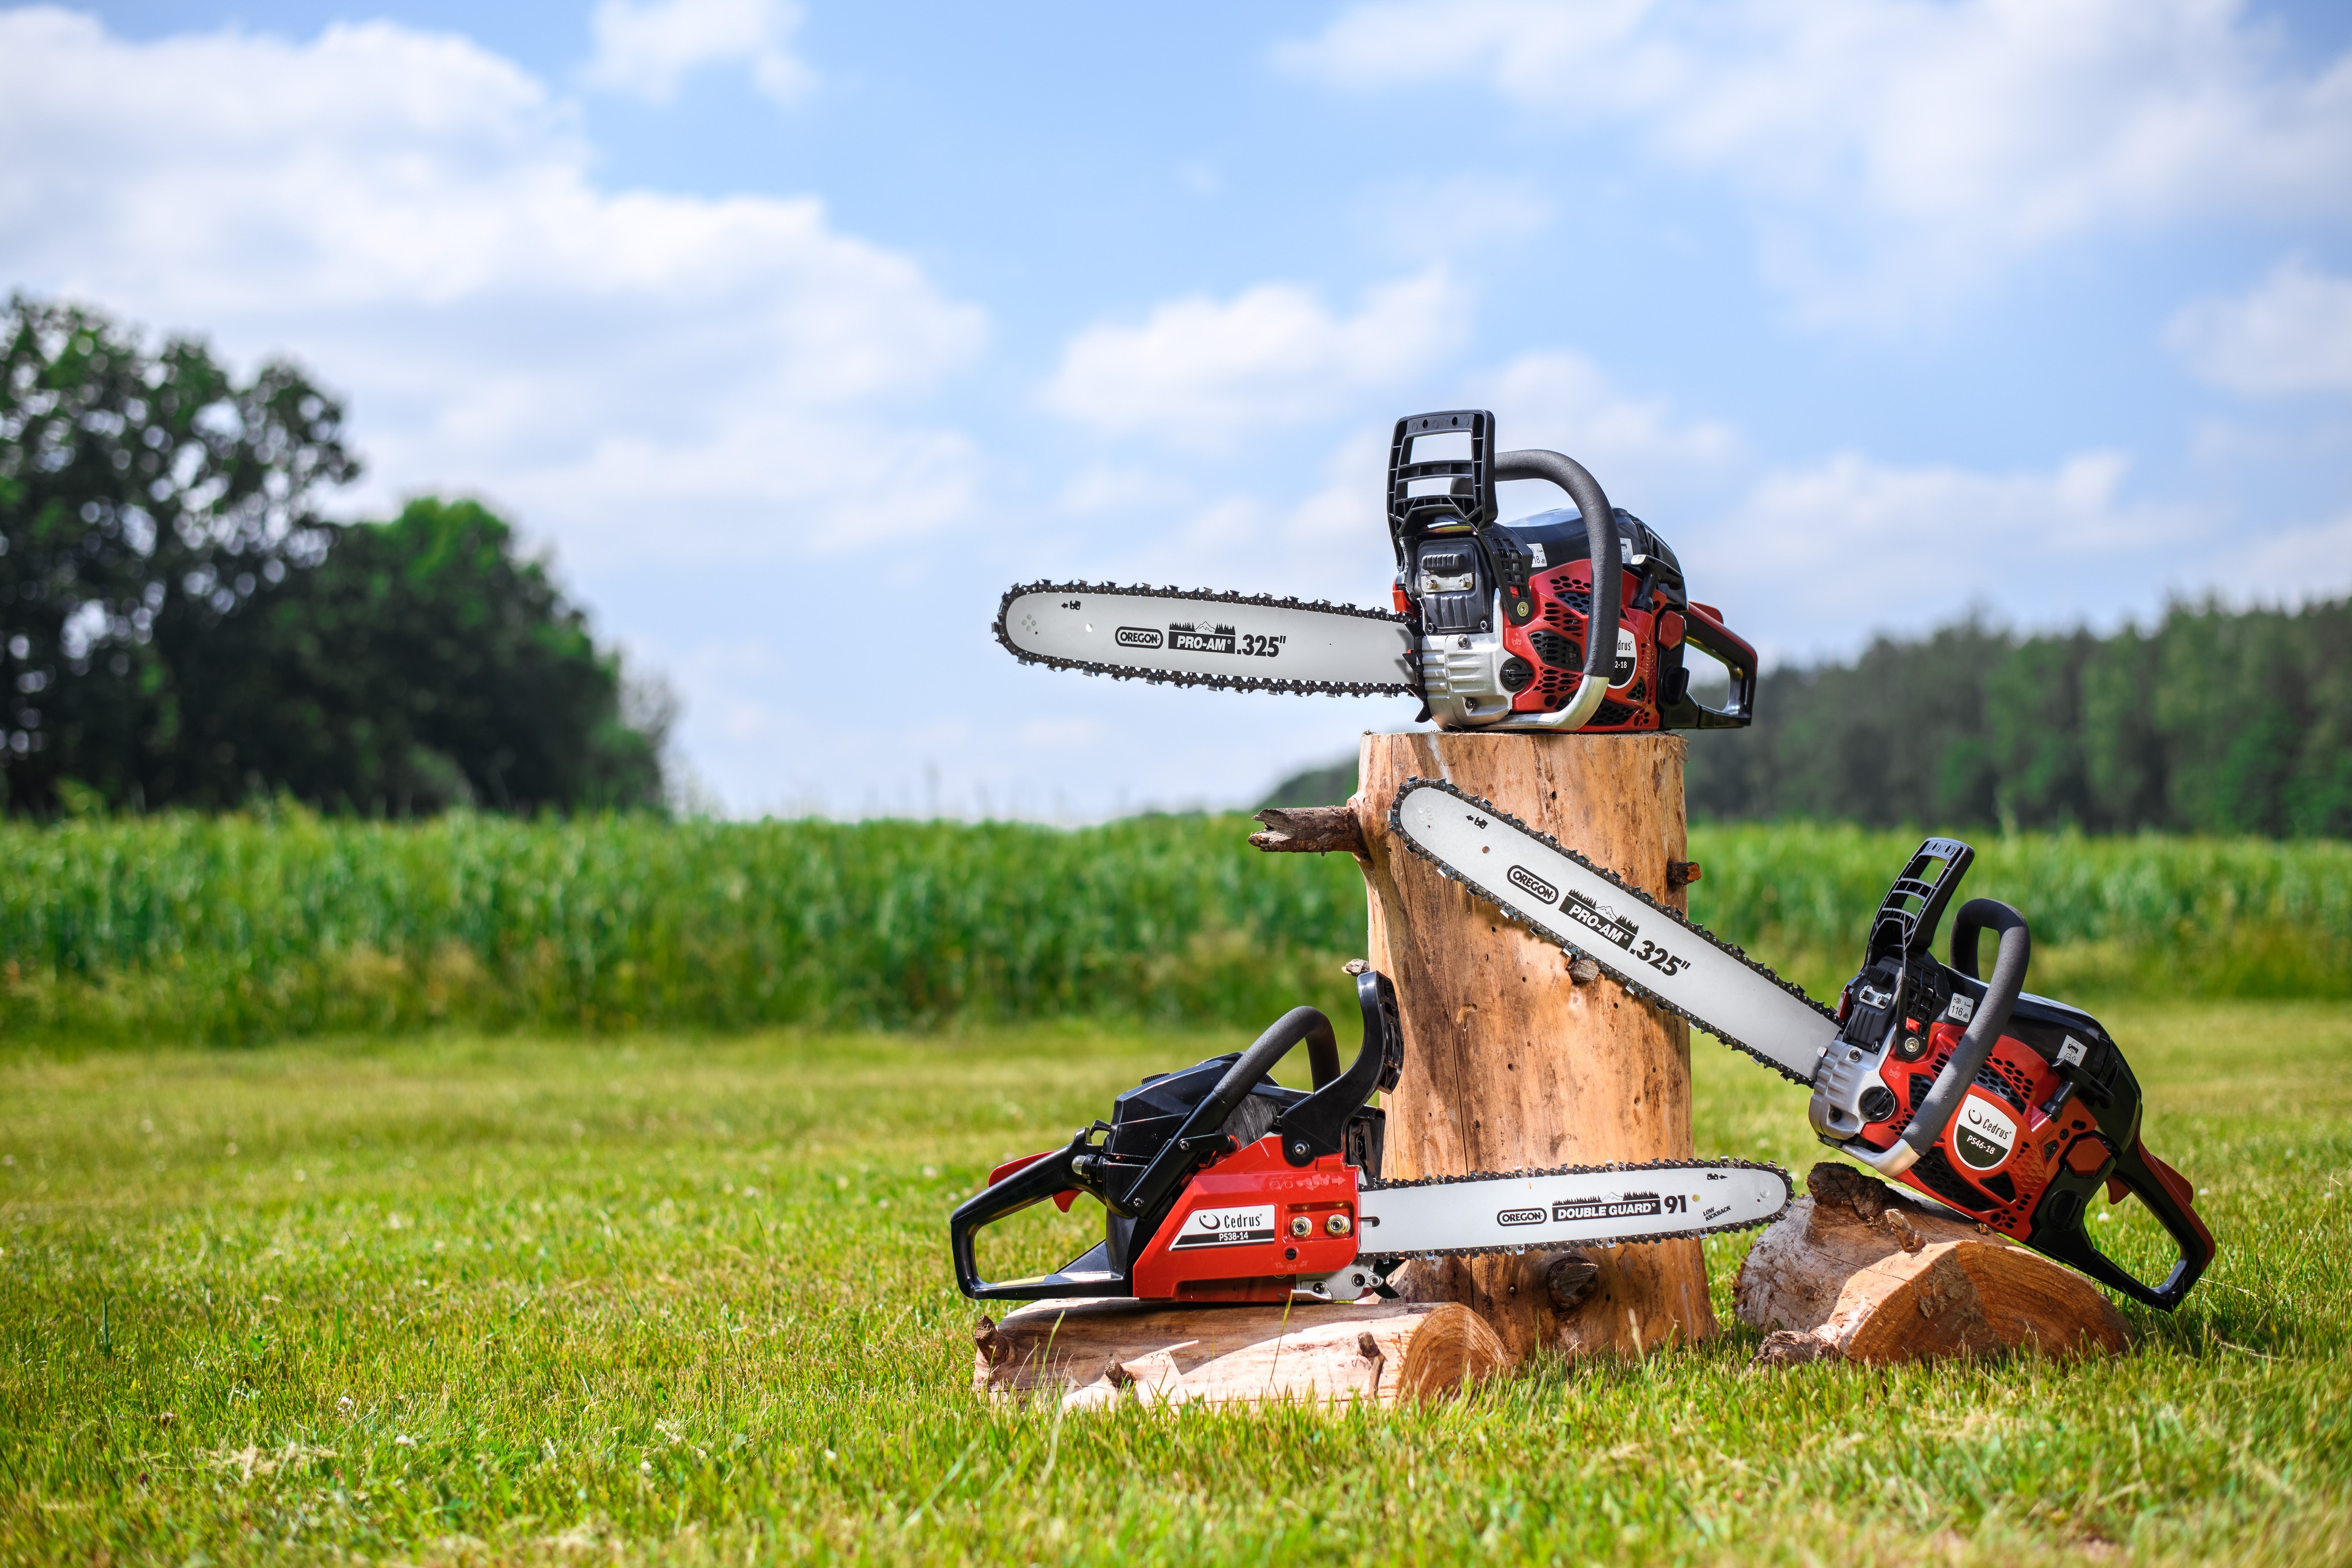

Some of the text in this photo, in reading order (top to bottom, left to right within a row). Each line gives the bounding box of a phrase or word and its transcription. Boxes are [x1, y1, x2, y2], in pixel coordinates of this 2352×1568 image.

[1120, 631, 1158, 644] OREGON
[1512, 870, 1554, 900] OREGON
[1952, 1005, 1963, 1016] 116
[1966, 1134, 1995, 1155] PS46-18
[1664, 1195, 1686, 1214] 91
[1502, 1211, 1542, 1222] OREGON
[1558, 1206, 1607, 1219] DOUBLE
[1703, 1207, 1714, 1217] LOW
[1705, 1205, 1731, 1221] KICKBACK
[1219, 1232, 1249, 1241] PS38-14
